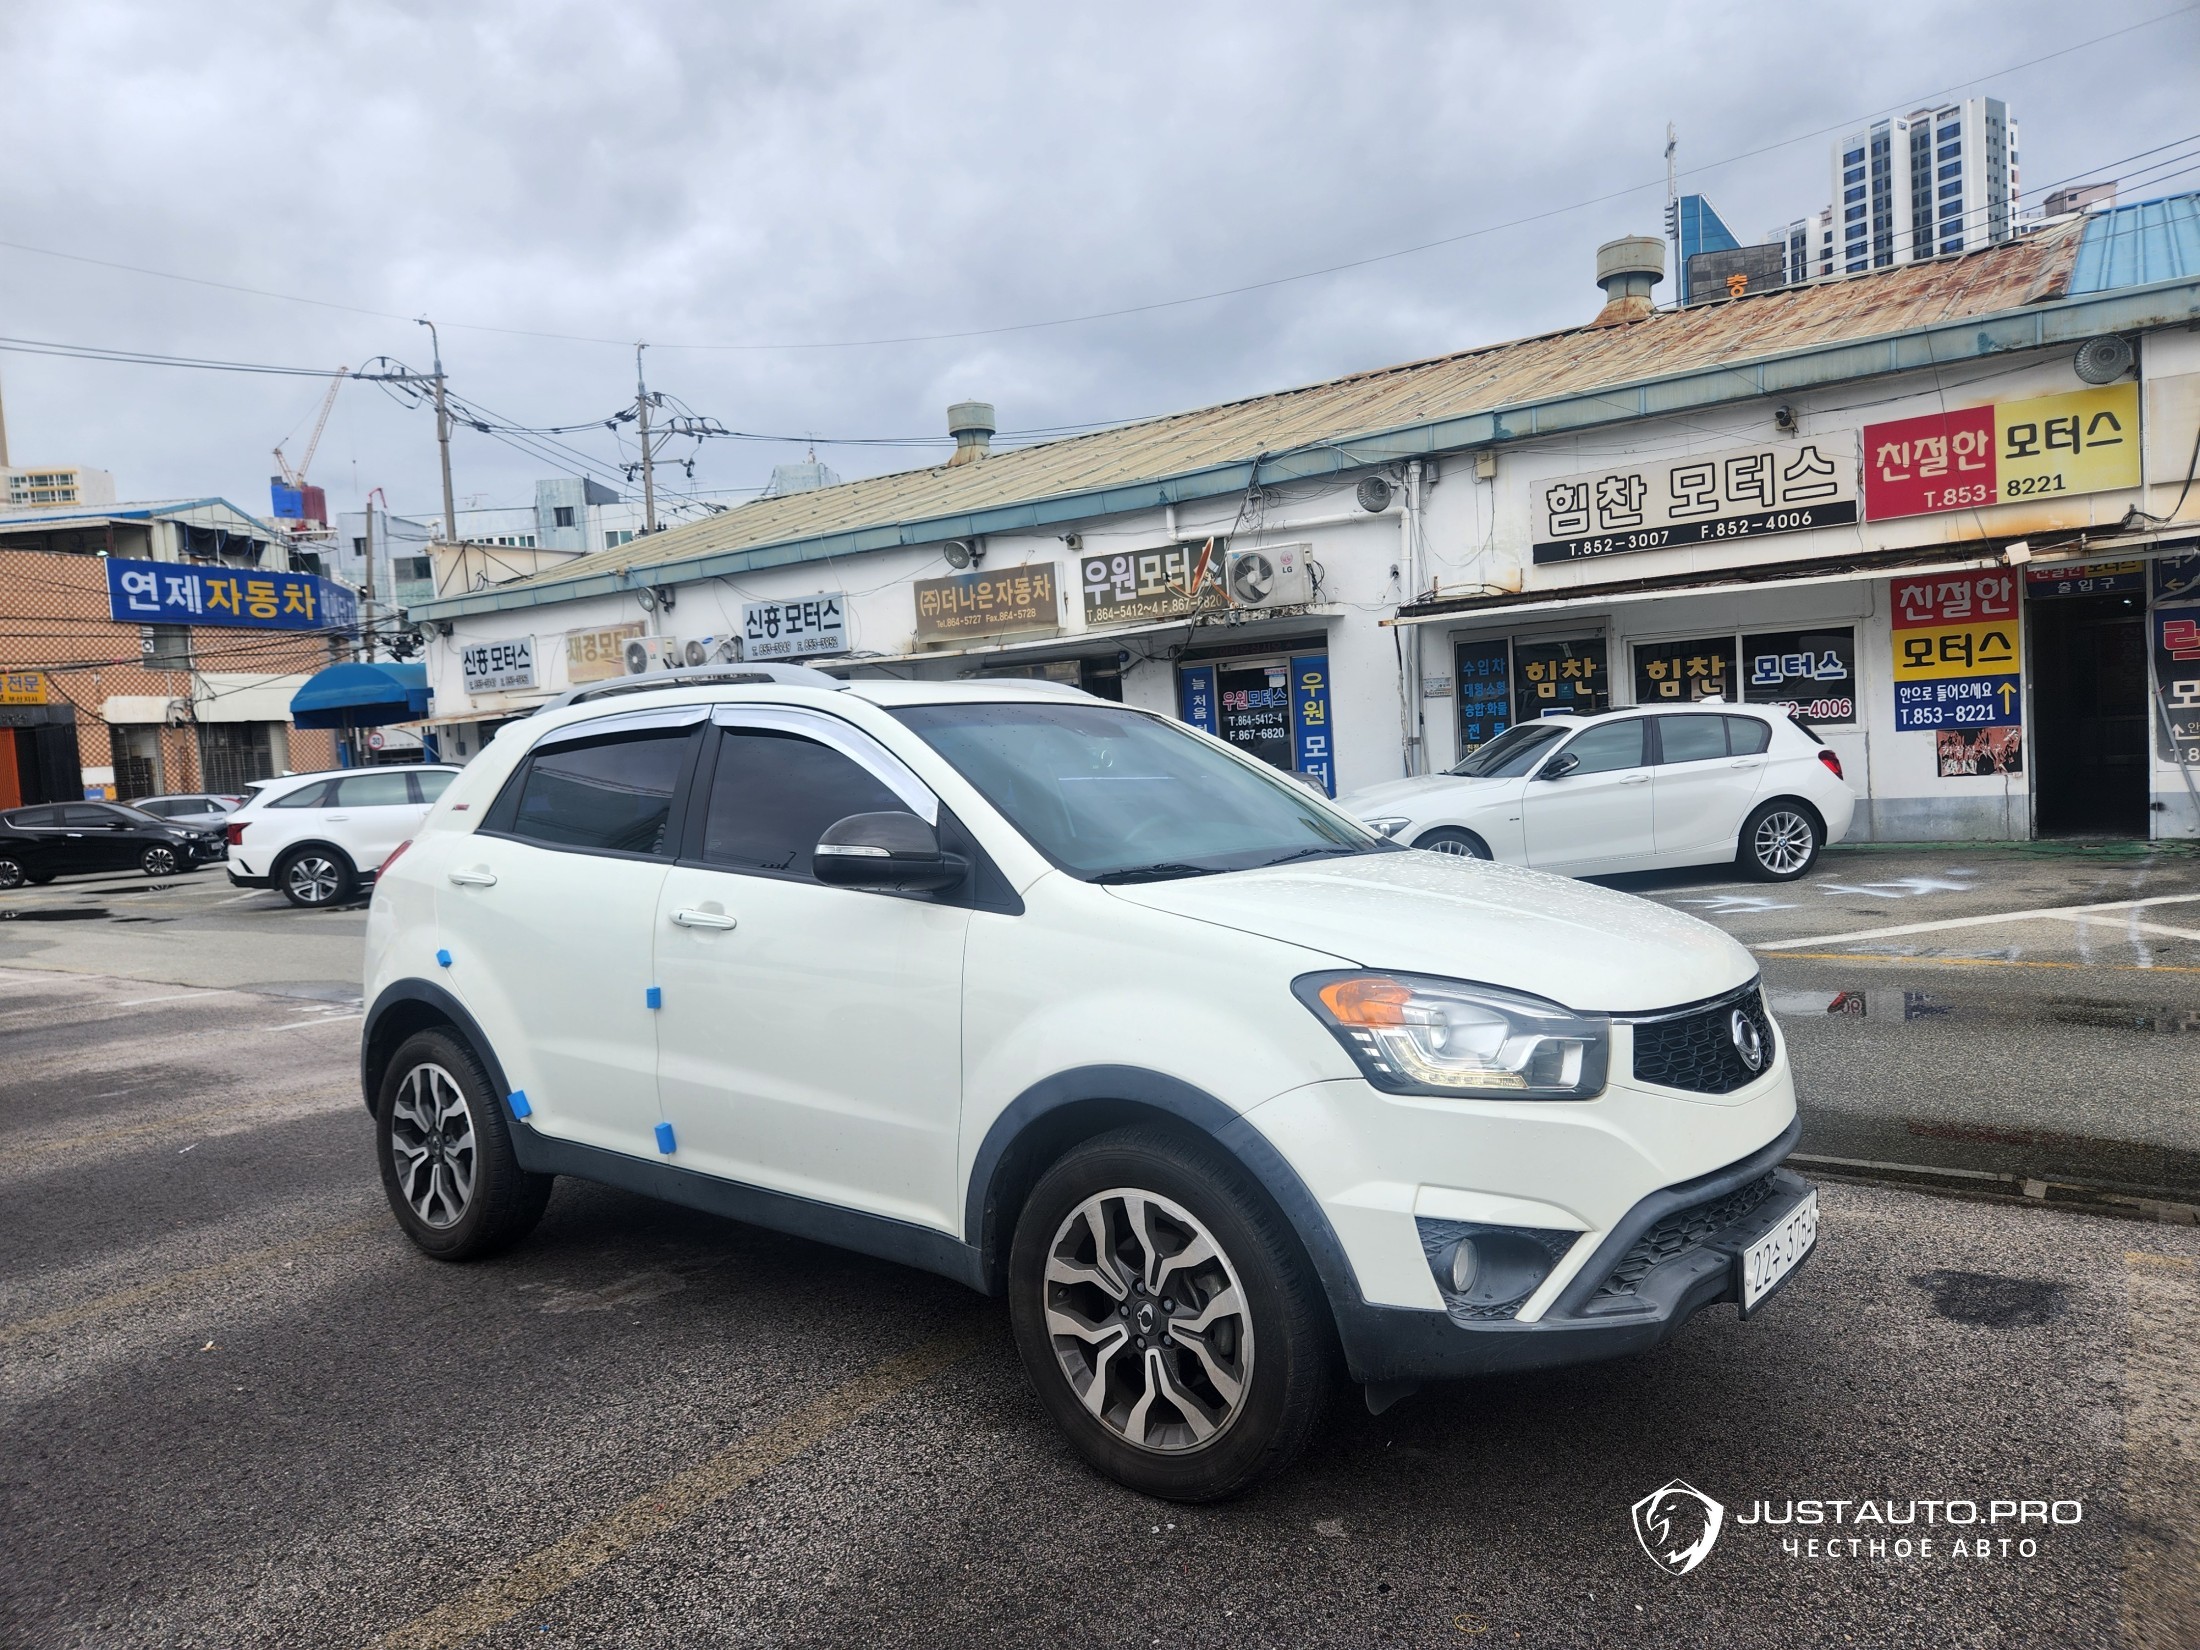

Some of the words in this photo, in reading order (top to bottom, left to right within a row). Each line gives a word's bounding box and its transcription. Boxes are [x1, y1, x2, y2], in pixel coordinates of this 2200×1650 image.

[1876, 430, 1989, 482] 친절한
[2005, 411, 2123, 459] 모터스
[1546, 475, 1647, 537] 힘찬
[1669, 446, 1837, 518] 모터스
[1569, 531, 1669, 556] T.852-3007
[1700, 511, 1813, 539] F.852-4006
[1282, 566, 1293, 574] LG
[785, 599, 842, 634] 모터스
[1087, 602, 1158, 623] T.864-5412~4
[1900, 577, 2013, 621] 친절한
[491, 643, 531, 672] 모터스
[1463, 658, 1506, 677] 수입차
[1903, 632, 2013, 668] 모터스
[1525, 657, 1597, 699] 힘찬
[1646, 655, 1726, 697] 힘찬
[1751, 651, 1848, 684] 모터스
[1900, 686, 1933, 704] 안으로
[1937, 682, 1992, 702] 들어오세요
[1901, 704, 1996, 725] T.853-8221
[1230, 728, 1285, 741] F.867-6820
[1754, 1239, 1780, 1293] 22수
[1787, 1203, 1812, 1262] 3754
